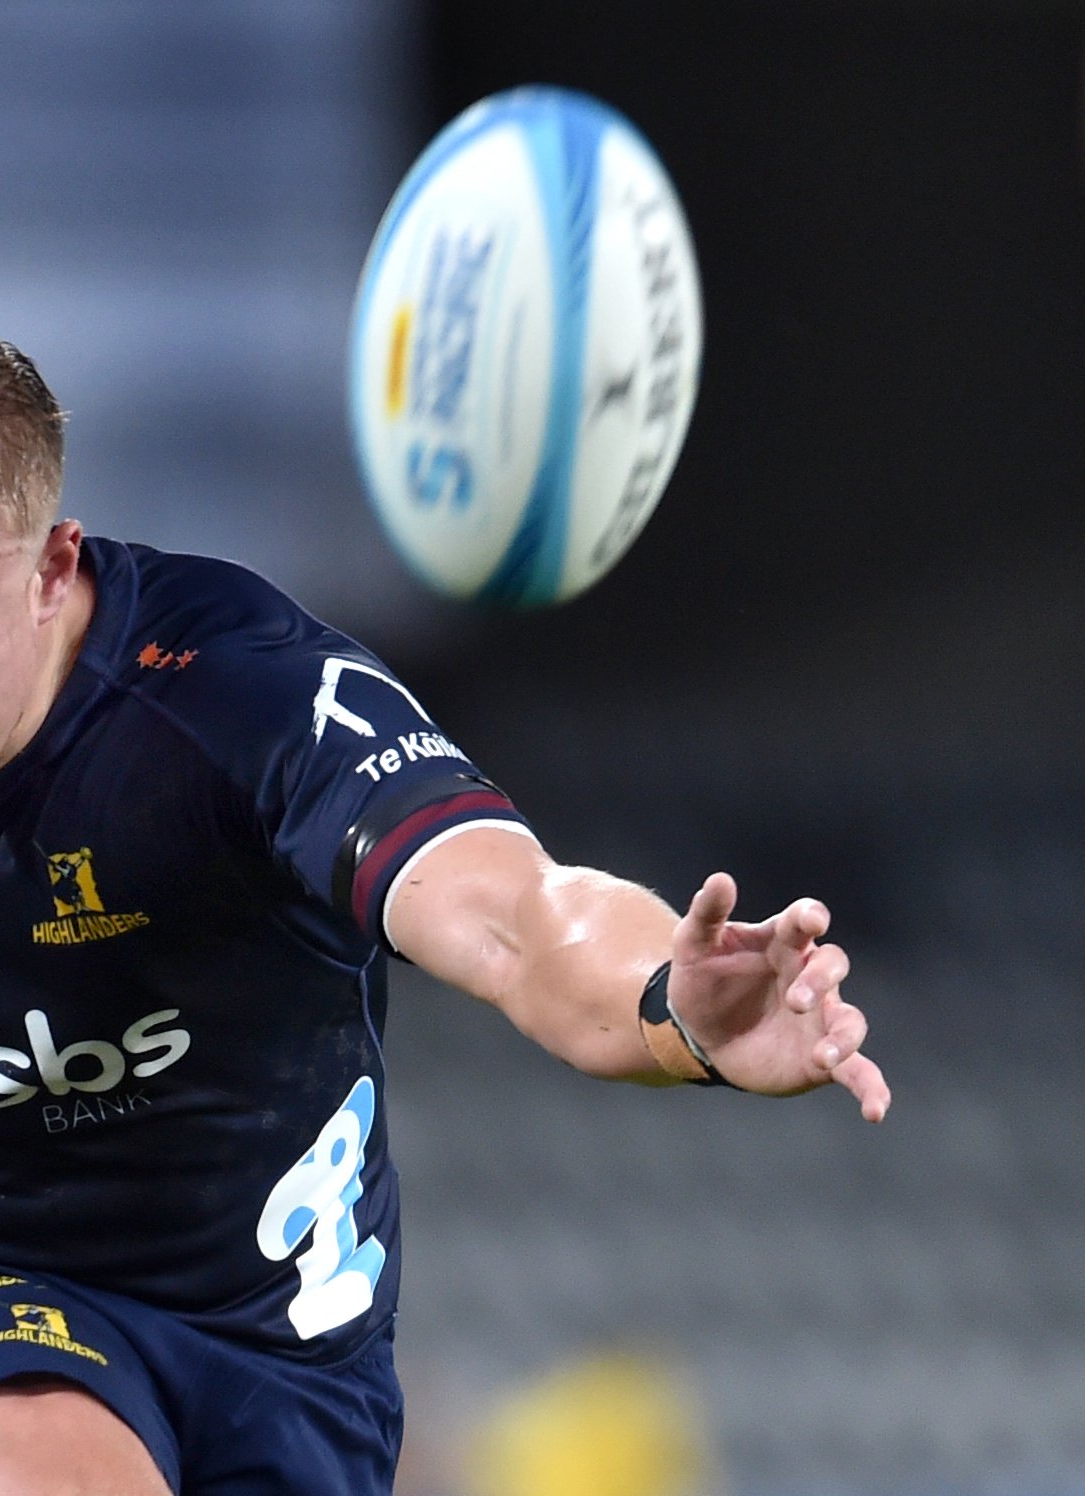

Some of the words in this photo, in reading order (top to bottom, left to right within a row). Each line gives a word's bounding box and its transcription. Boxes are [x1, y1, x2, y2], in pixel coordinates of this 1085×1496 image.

[355, 749, 402, 782] Te
[32, 911, 150, 944] HIGHLANDERS
[42, 1088, 152, 1134] BANK
